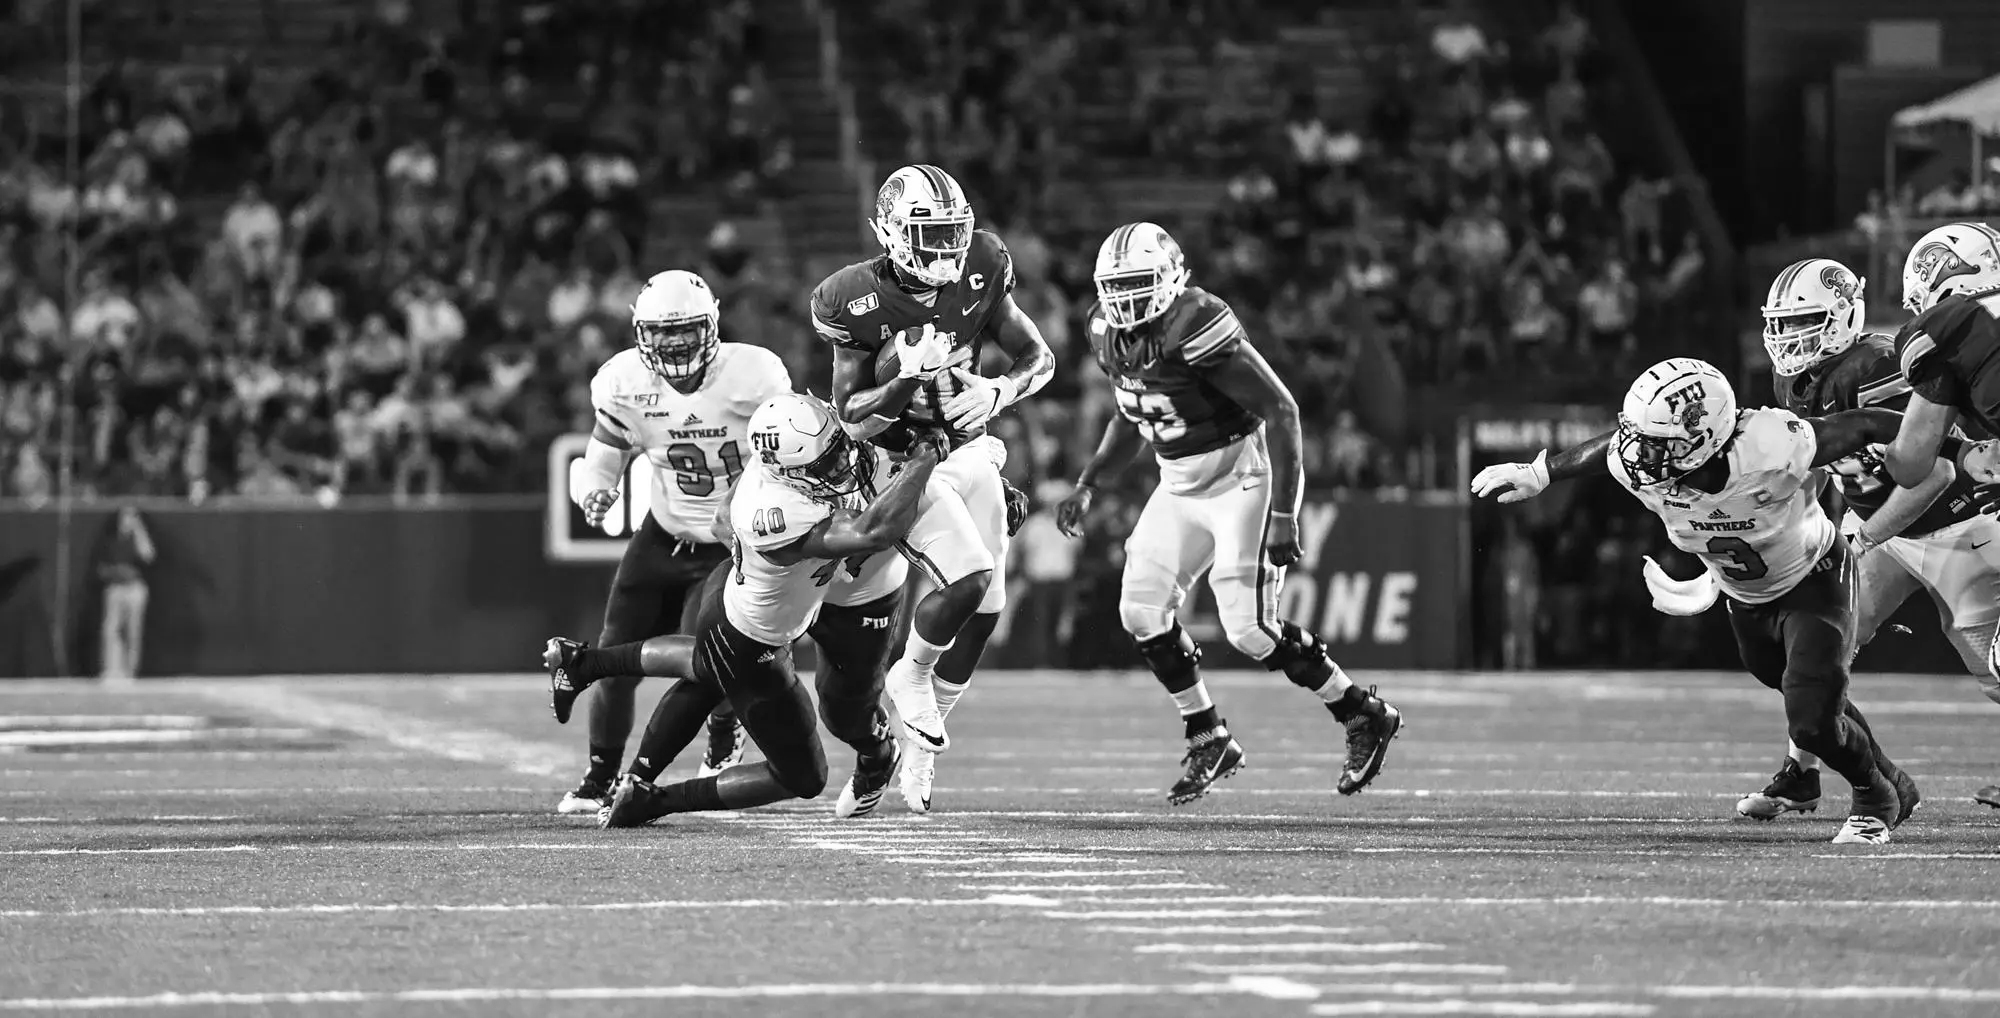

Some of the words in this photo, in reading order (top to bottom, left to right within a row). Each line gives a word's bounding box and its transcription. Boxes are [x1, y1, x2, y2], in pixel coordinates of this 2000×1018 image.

[969, 273, 985, 290] C
[847, 292, 879, 315] 150
[1664, 381, 1707, 415] FIU
[667, 426, 728, 439] PANTHERS
[752, 432, 780, 450] FIU
[667, 440, 744, 497] 91
[752, 507, 787, 537] 40
[1687, 518, 1757, 532] PANTHERS
[1706, 536, 1769, 581] 3
[862, 616, 889, 629] FIU
